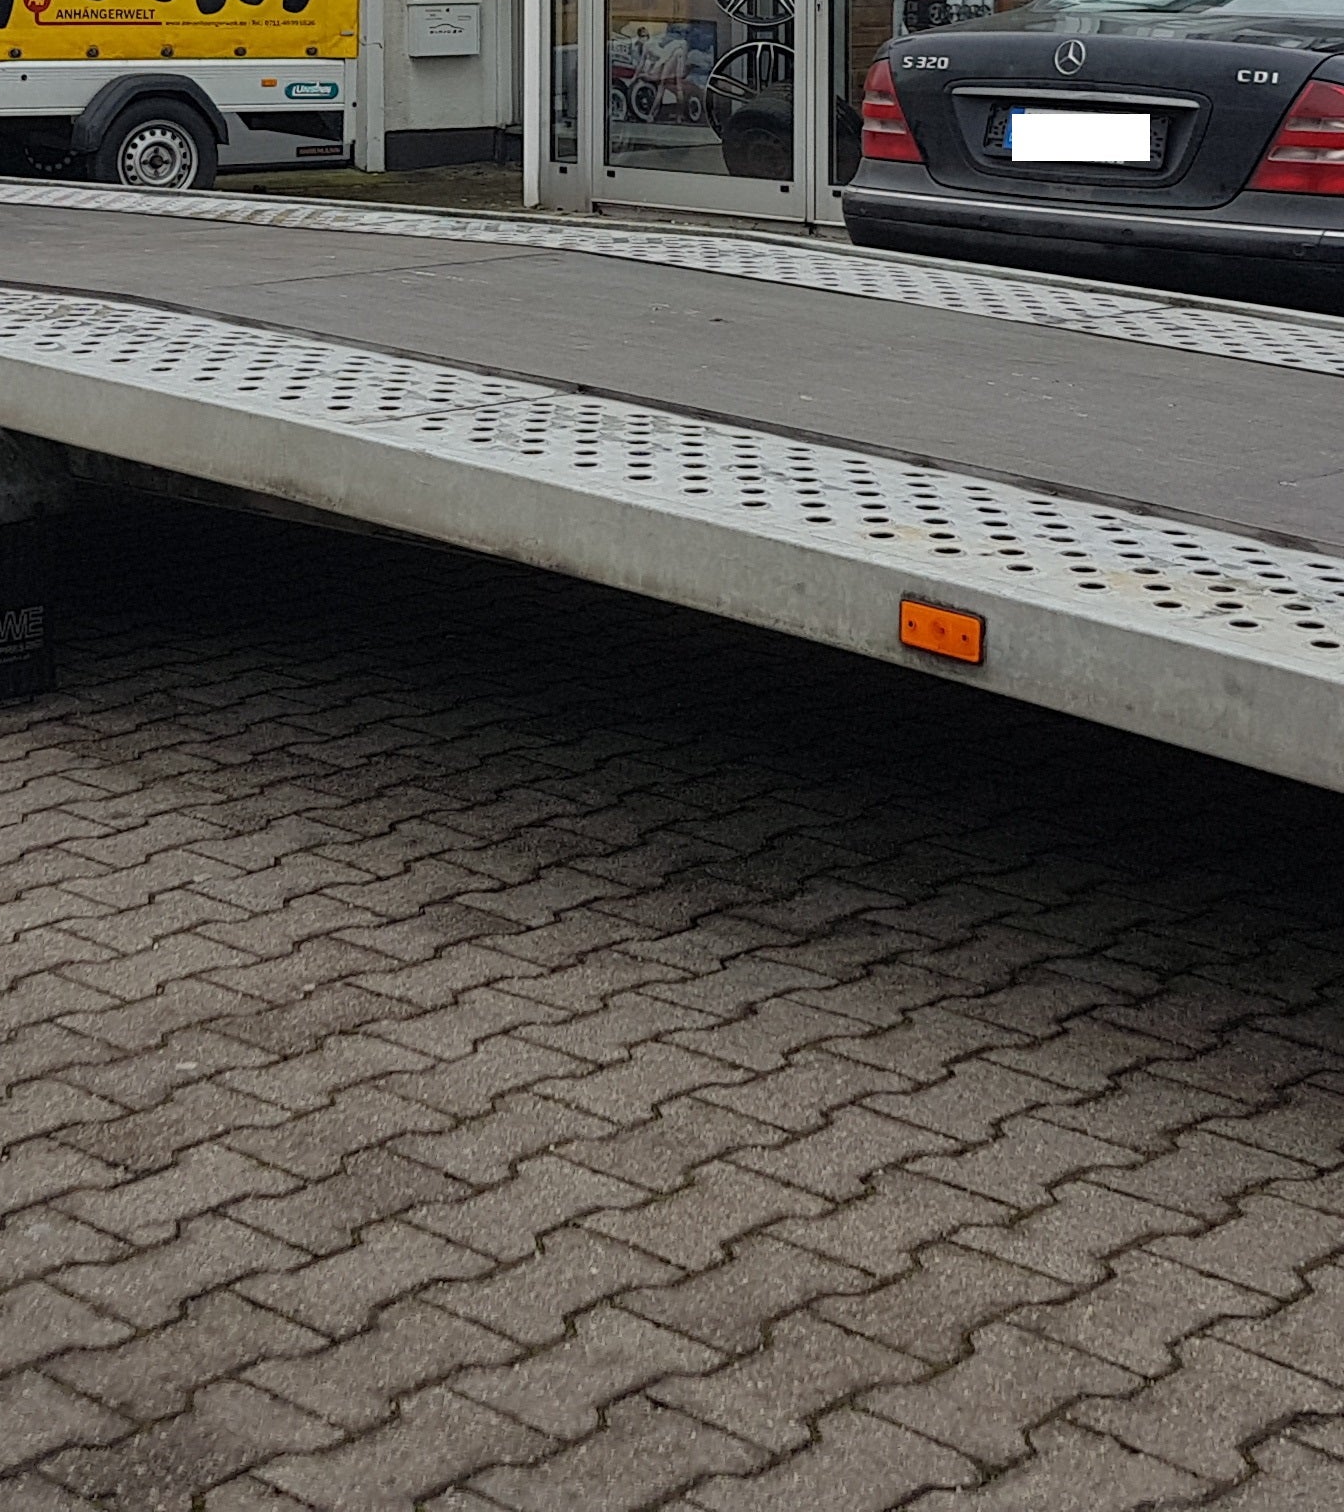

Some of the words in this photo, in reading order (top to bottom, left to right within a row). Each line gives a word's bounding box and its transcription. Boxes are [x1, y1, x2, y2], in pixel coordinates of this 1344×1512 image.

[56, 7, 155, 20] ANHÄNGERWELT
[902, 56, 914, 68] S
[916, 56, 949, 69] 320
[1237, 69, 1279, 84] CDI
